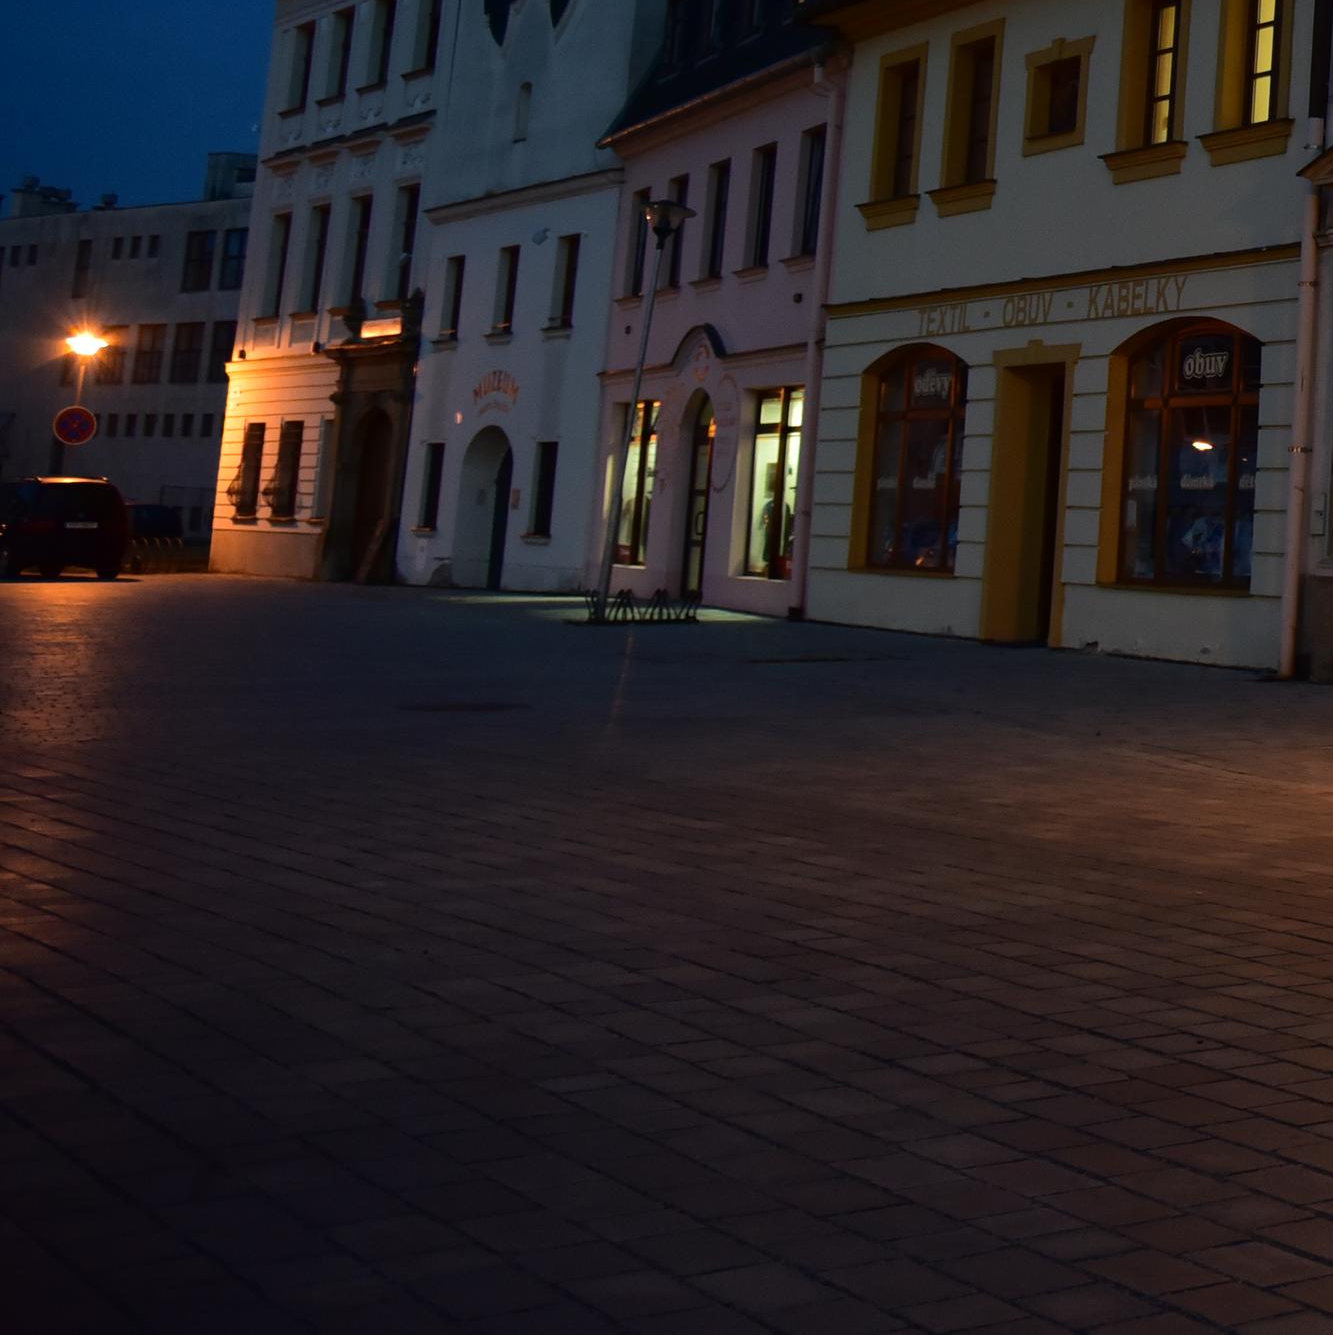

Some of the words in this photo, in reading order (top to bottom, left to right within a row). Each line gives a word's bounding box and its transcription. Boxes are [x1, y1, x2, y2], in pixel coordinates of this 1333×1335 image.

[918, 303, 970, 336] TEXTIL
[1003, 292, 1054, 327] OBUV
[1088, 275, 1188, 319] KABELKY
[1183, 347, 1229, 380] obuv
[914, 368, 951, 399] oděvy
